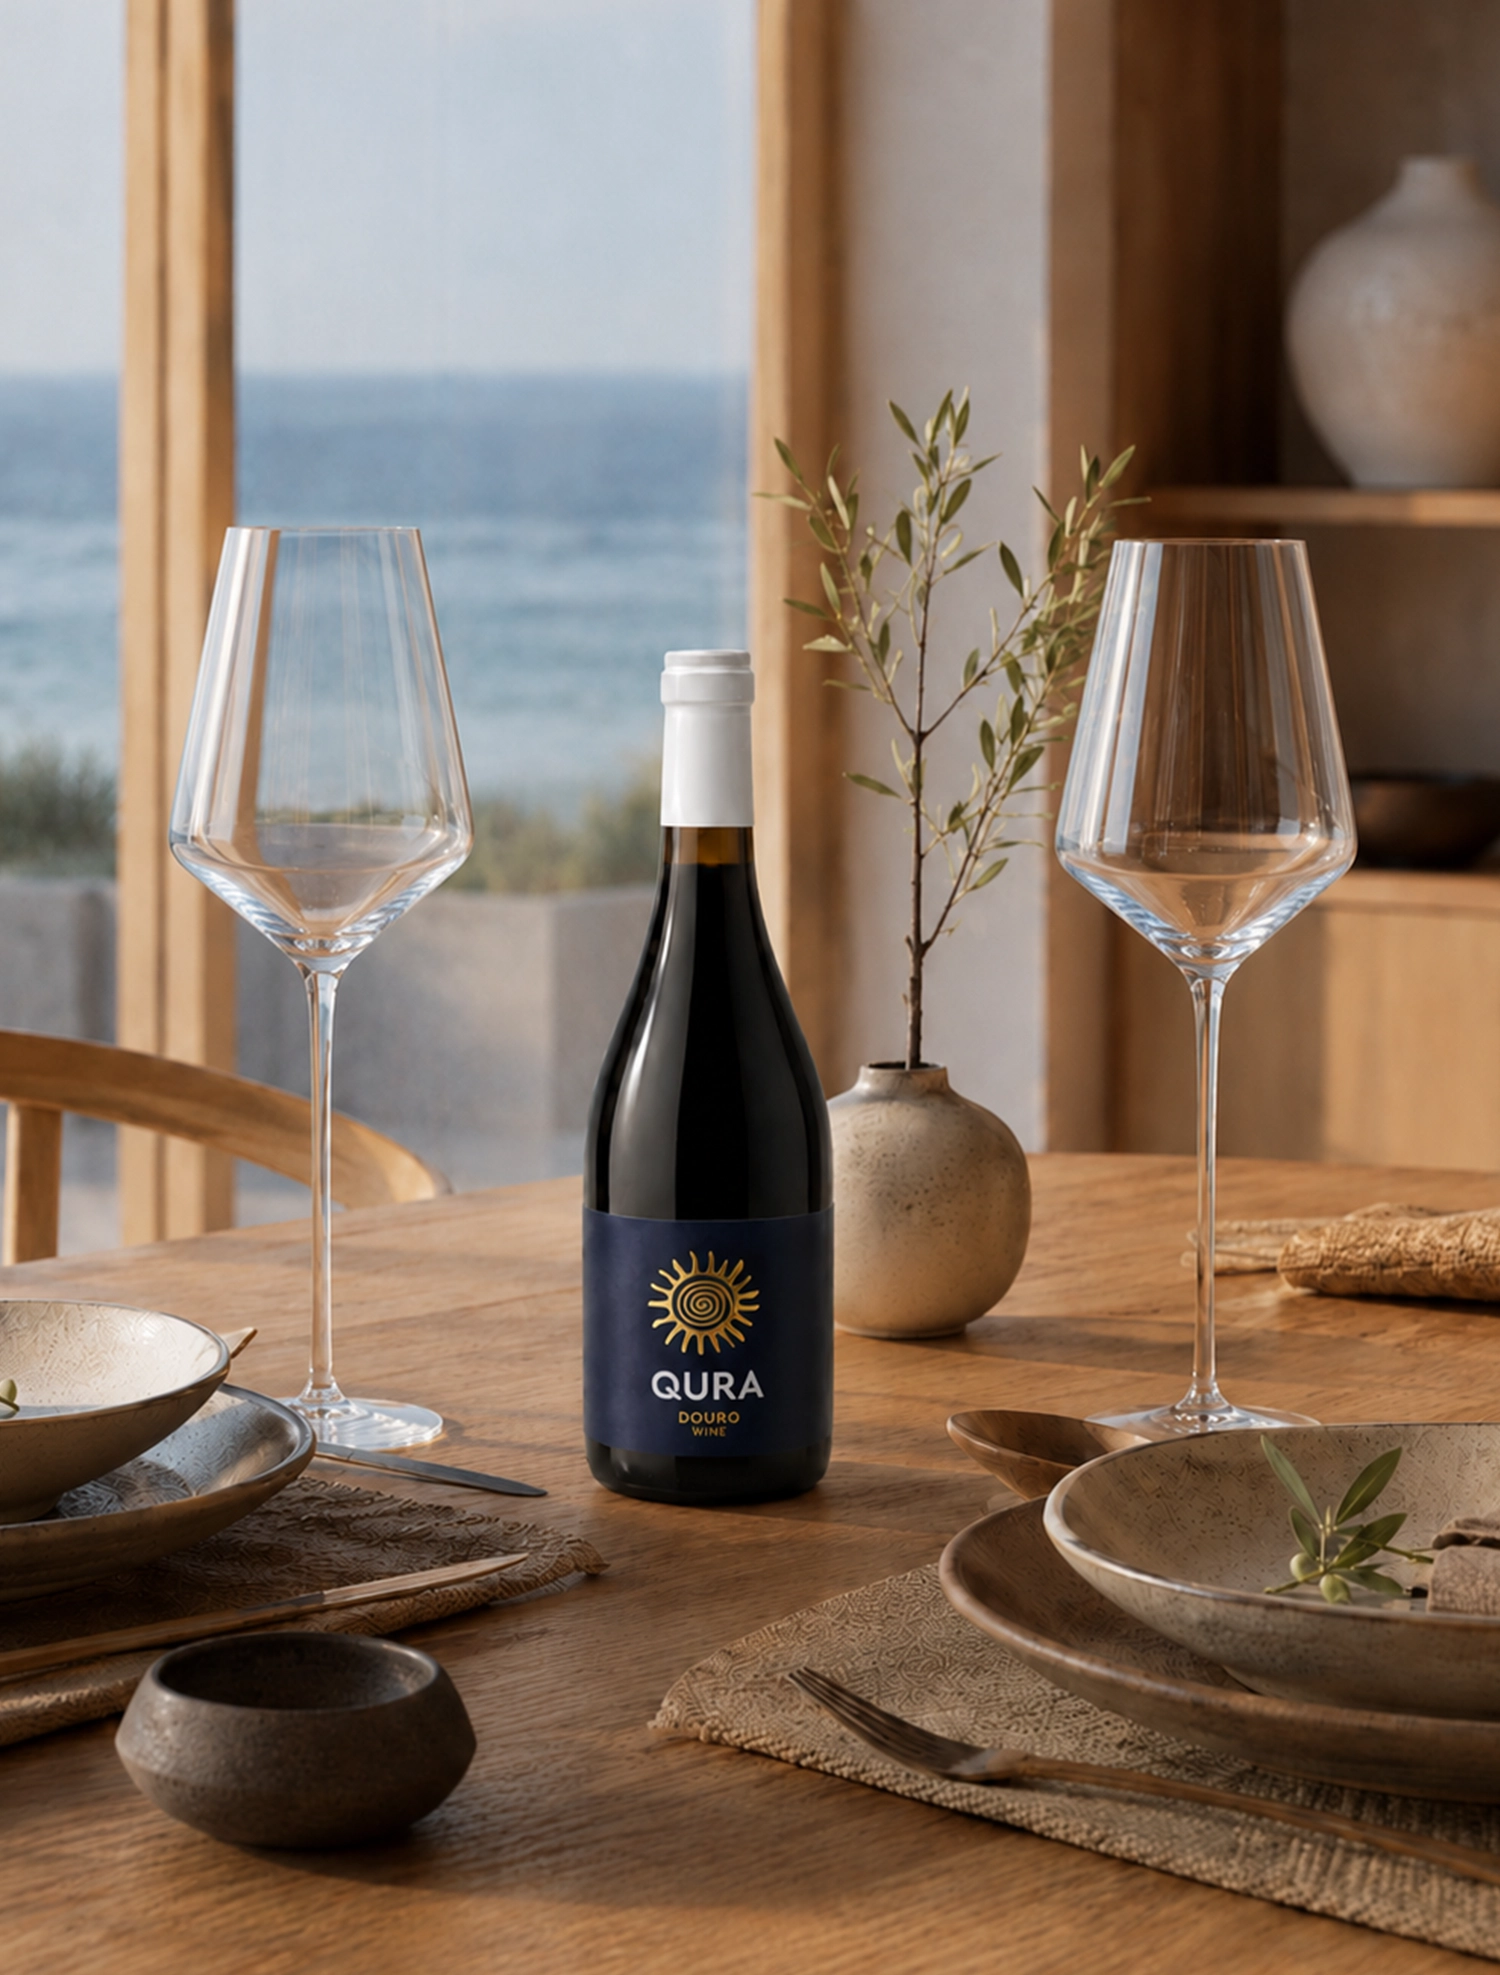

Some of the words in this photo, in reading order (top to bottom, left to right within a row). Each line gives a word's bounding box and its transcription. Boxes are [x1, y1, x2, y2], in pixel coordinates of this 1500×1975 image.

[652, 1370, 764, 1401] QURA
[678, 1411, 740, 1424] DOURO
[691, 1426, 727, 1437] WINE
